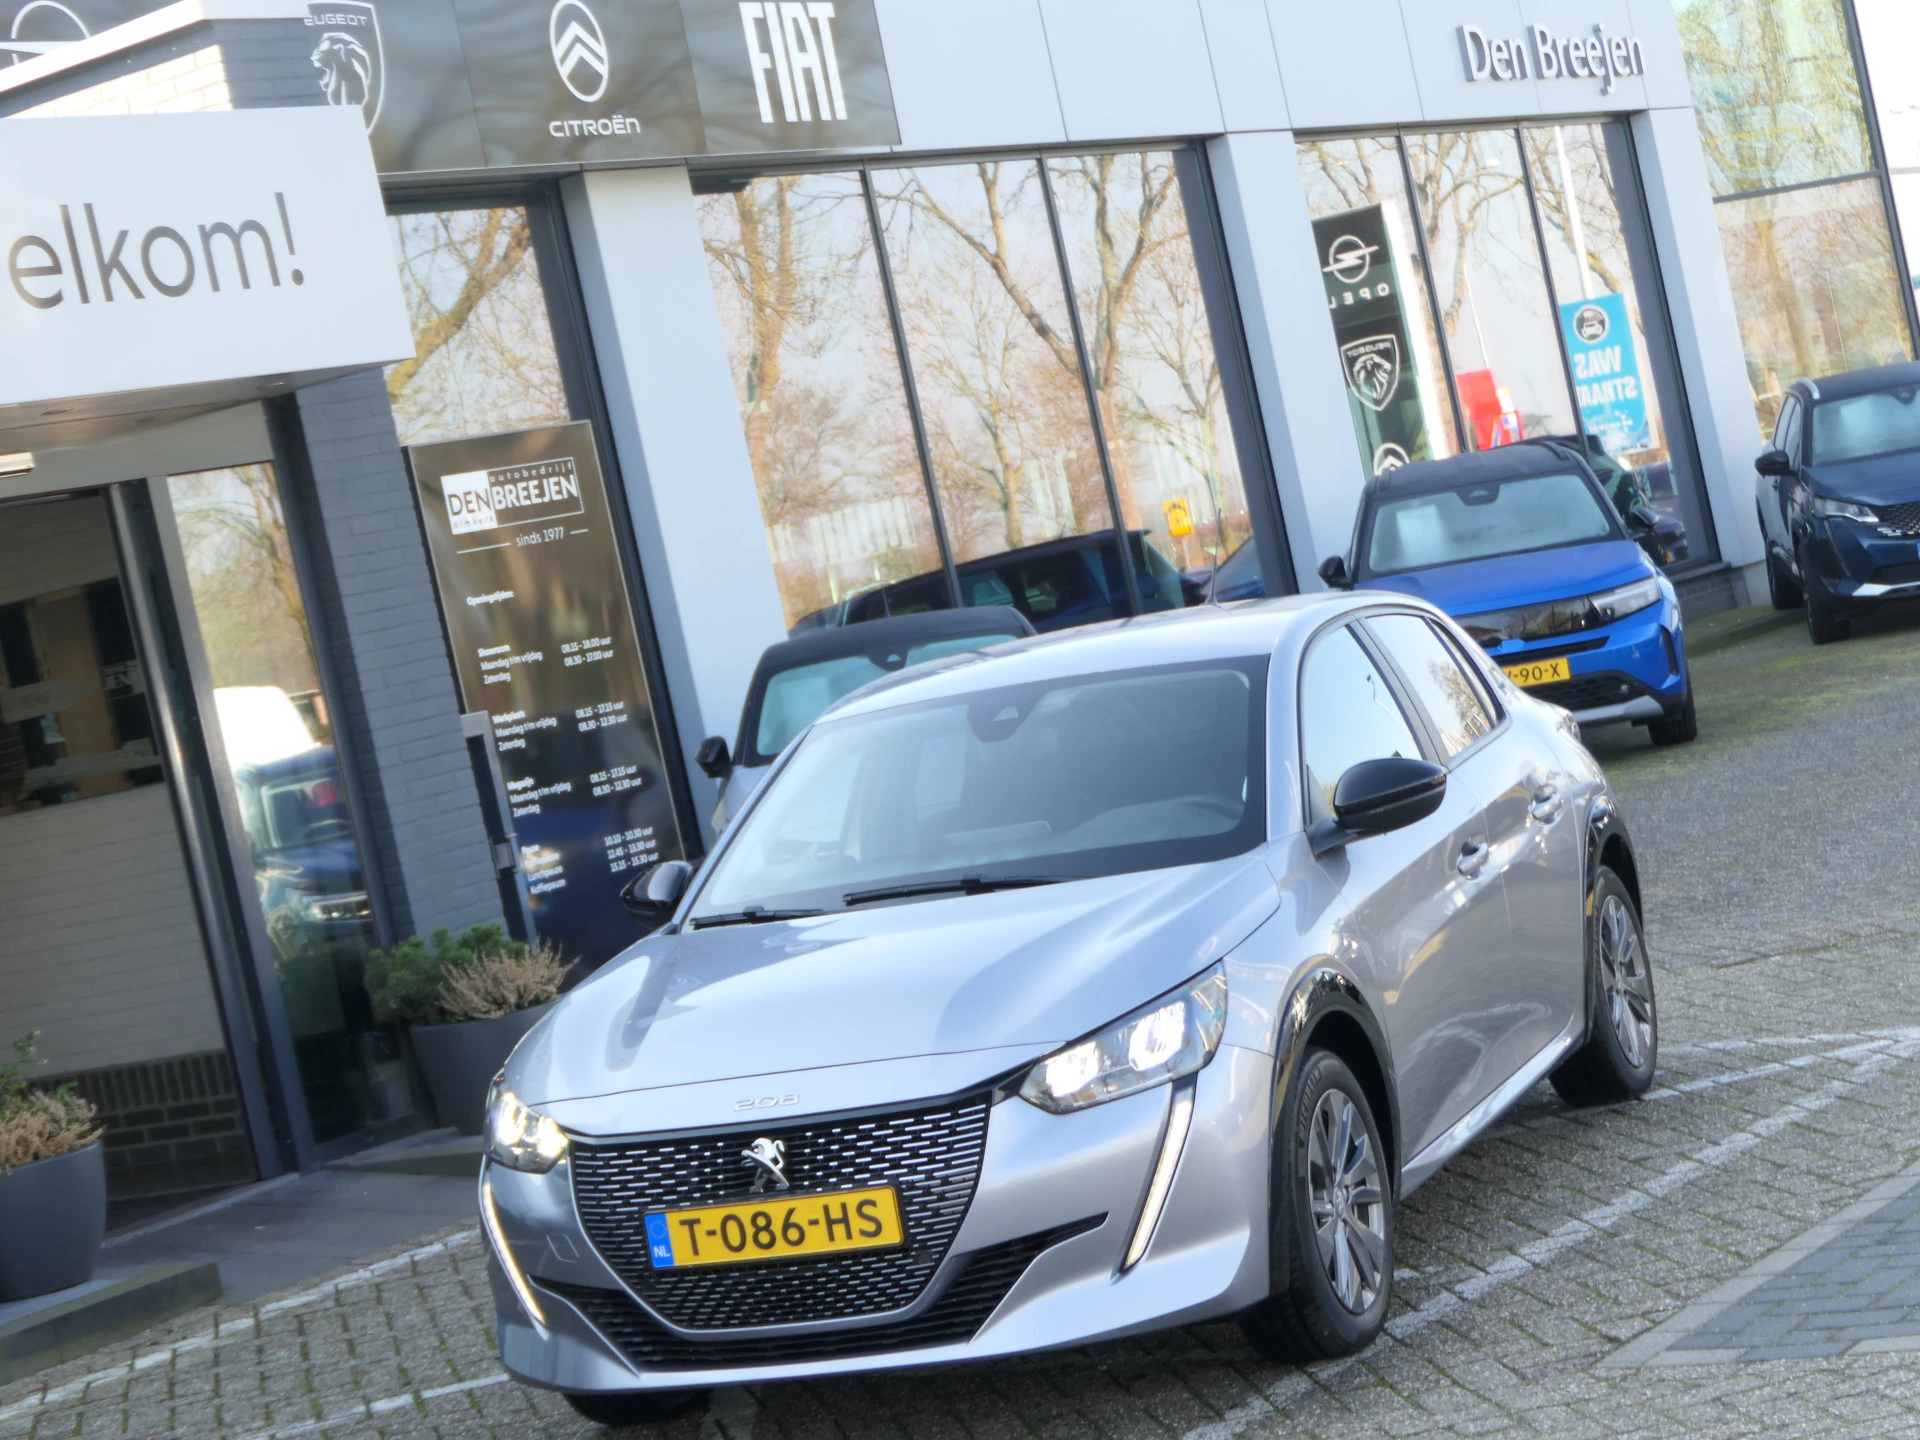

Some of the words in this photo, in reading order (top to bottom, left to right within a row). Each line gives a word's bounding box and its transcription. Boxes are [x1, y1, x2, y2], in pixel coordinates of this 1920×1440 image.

[739, 1, 848, 123] FIAT
[1457, 24, 1528, 83] Den
[1527, 23, 1647, 97] Breejen
[447, 487, 493, 517] DEN
[491, 474, 578, 511] BREEJEN
[516, 532, 541, 547] sinds
[543, 526, 565, 543] 1977
[561, 642, 579, 654] 08.15
[582, 638, 600, 650] 18.00
[600, 636, 611, 646] uur
[564, 655, 582, 667] 08.30
[602, 649, 614, 658] uur
[575, 707, 594, 719] 08.15
[613, 701, 624, 710] uur
[578, 720, 597, 732] 08.30
[616, 713, 627, 722] uur
[590, 771, 608, 784] 08.15
[626, 765, 637, 774] uur
[592, 784, 611, 797] 08.30
[630, 777, 642, 786] uur
[642, 826, 653, 835] uur
[607, 846, 624, 859] 12.45
[645, 839, 656, 848] uur
[648, 852, 659, 862] uur
[733, 1094, 801, 1112] 208
[678, 1198, 884, 1257] T-086-HS
[653, 1245, 671, 1258] NL
